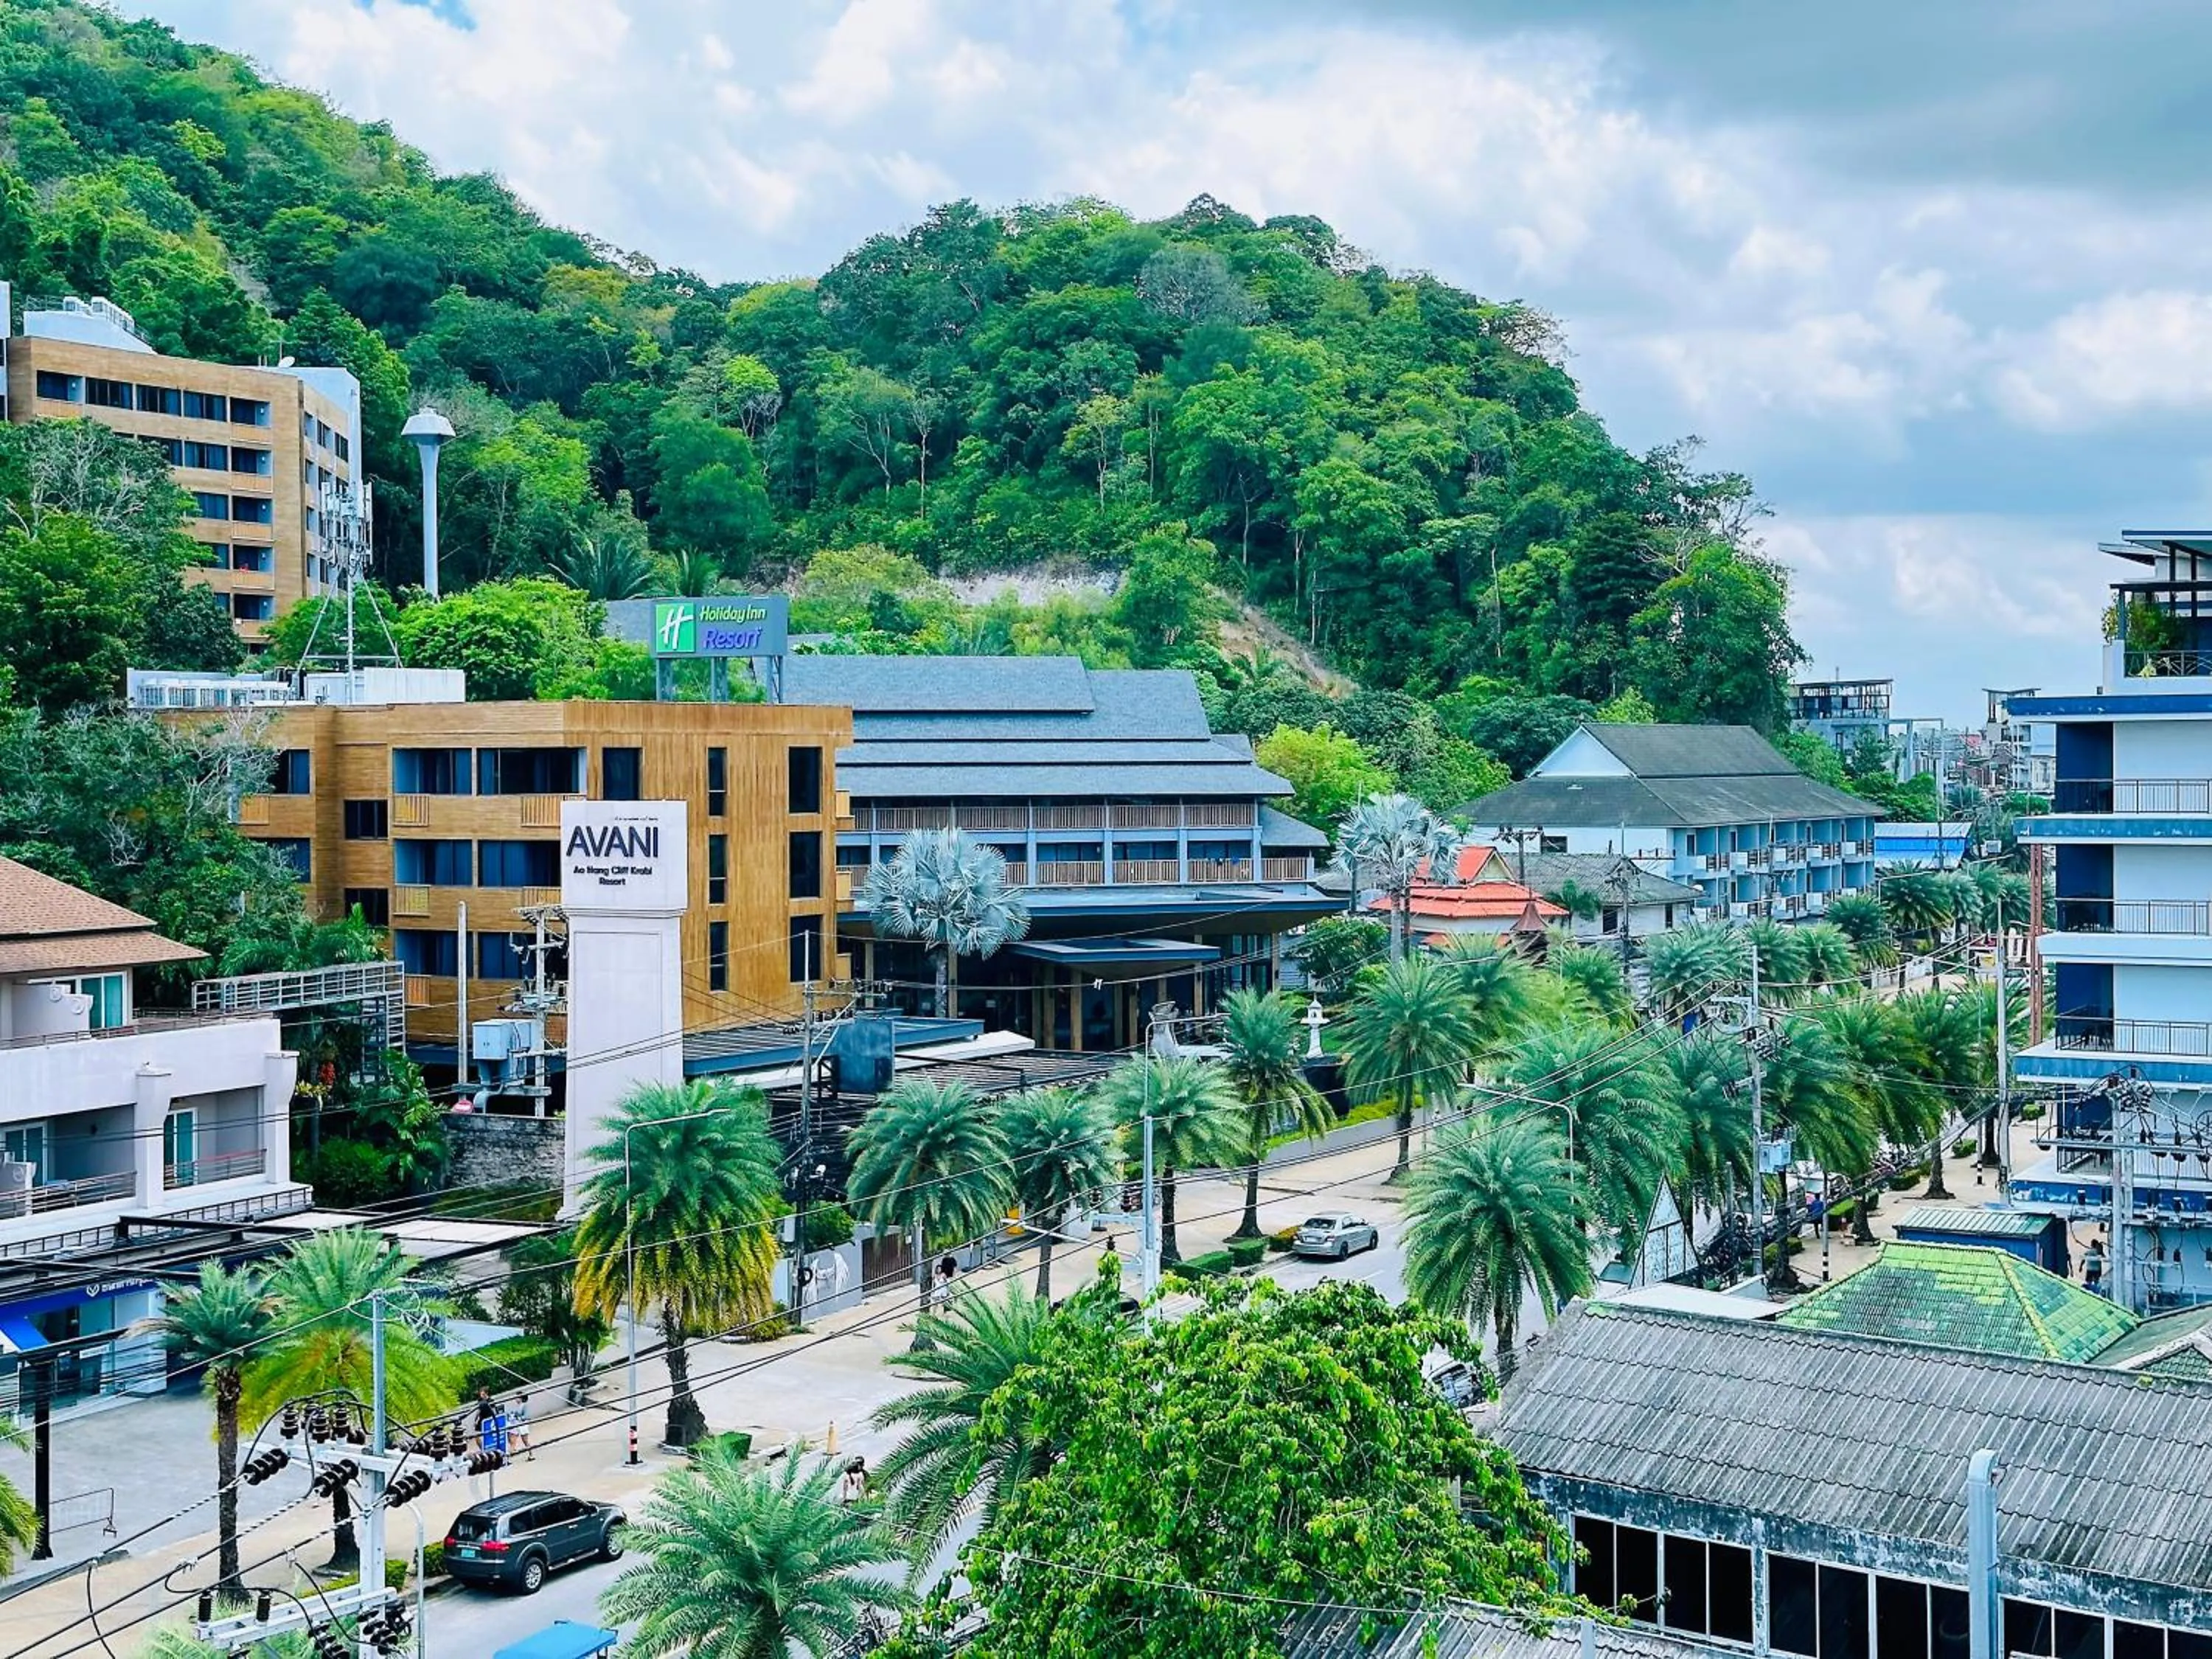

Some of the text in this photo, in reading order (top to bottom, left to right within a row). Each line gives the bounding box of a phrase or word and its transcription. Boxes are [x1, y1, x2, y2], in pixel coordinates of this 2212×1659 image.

[700, 604, 766, 623] Holiday Inn
[703, 627, 762, 649] Resort
[566, 826, 658, 858] AVANI
[574, 866, 585, 874] Ao
[599, 877, 625, 886] Resort
